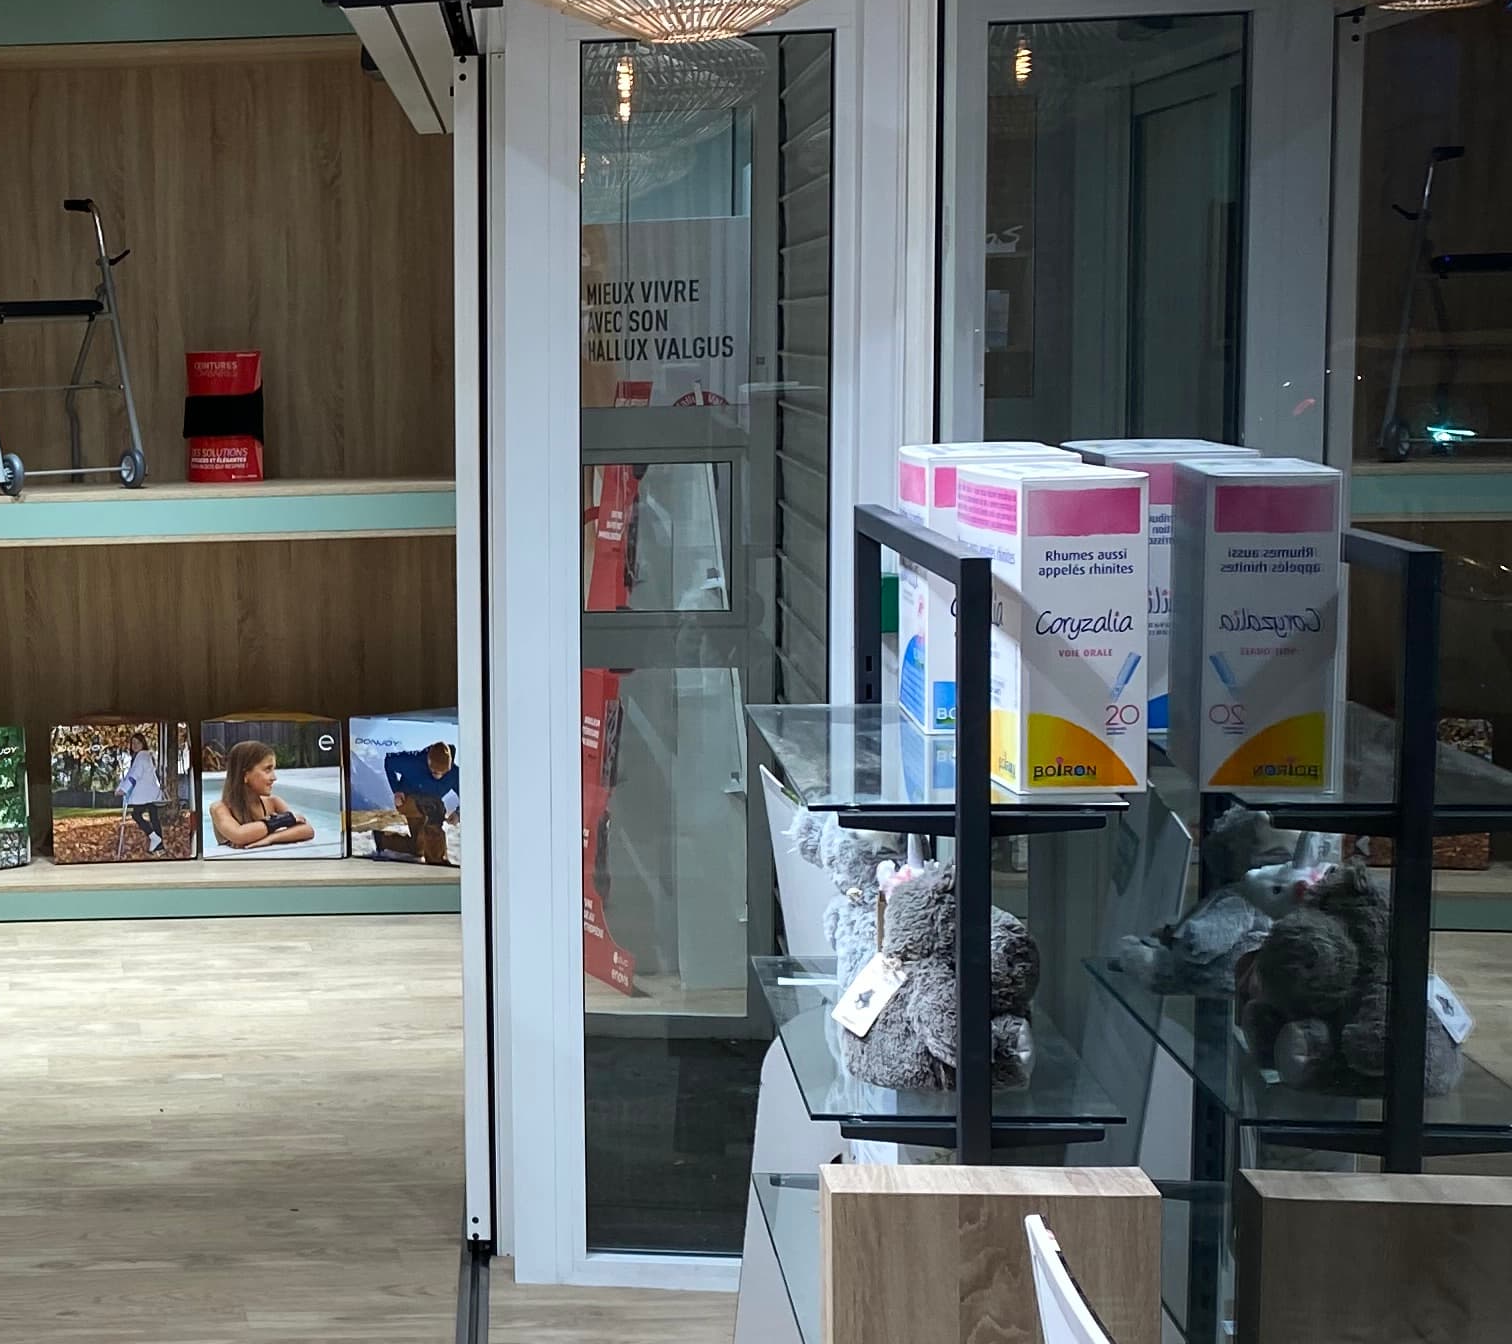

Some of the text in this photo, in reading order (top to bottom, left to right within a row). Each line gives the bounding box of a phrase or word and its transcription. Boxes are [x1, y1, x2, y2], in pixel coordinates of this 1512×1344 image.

[587, 279, 700, 306] MIEUX VIVRE
[588, 309, 668, 334] AVEC SON
[588, 335, 734, 362] HALLUX VALGUS
[201, 447, 248, 457] SOLUTIONS
[1045, 548, 1127, 562] Rhumes aussi
[1038, 563, 1134, 578] appelés rhinites
[1035, 609, 1134, 640] Coryzalia
[1059, 649, 1112, 657] VOIE ORALE
[1105, 704, 1140, 725] 20
[1033, 757, 1097, 777] BOIRON
